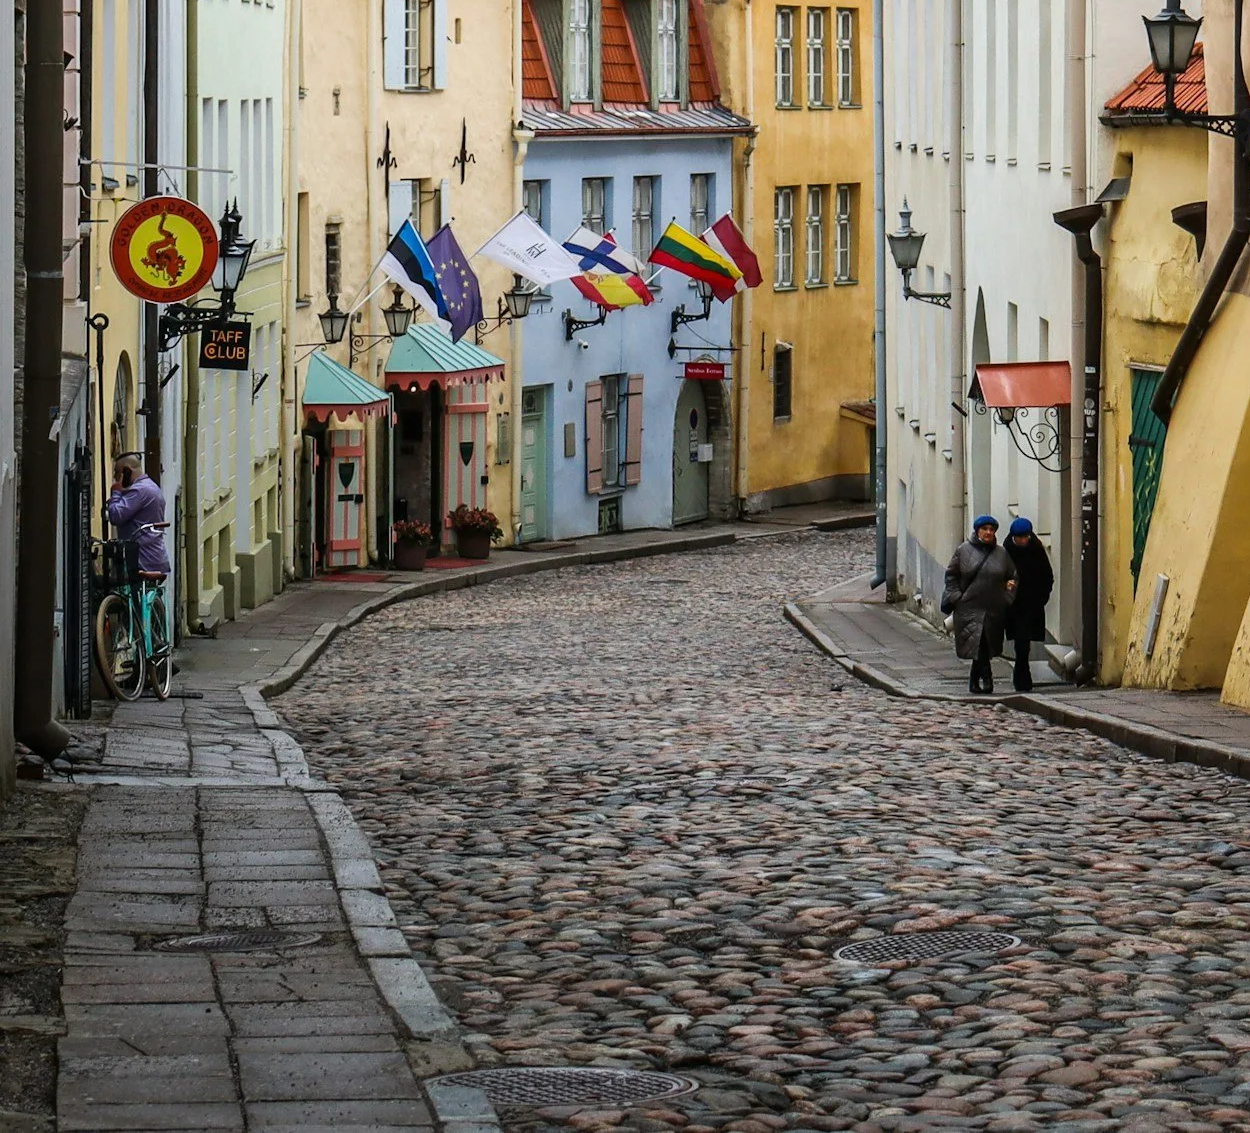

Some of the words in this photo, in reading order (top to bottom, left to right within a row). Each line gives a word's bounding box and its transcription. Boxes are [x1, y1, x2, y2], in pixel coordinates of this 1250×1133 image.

[117, 201, 160, 246] GOLDEN
[167, 201, 214, 245] DRAGON
[210, 329, 244, 344] TAFF
[204, 342, 246, 360] CLUB
